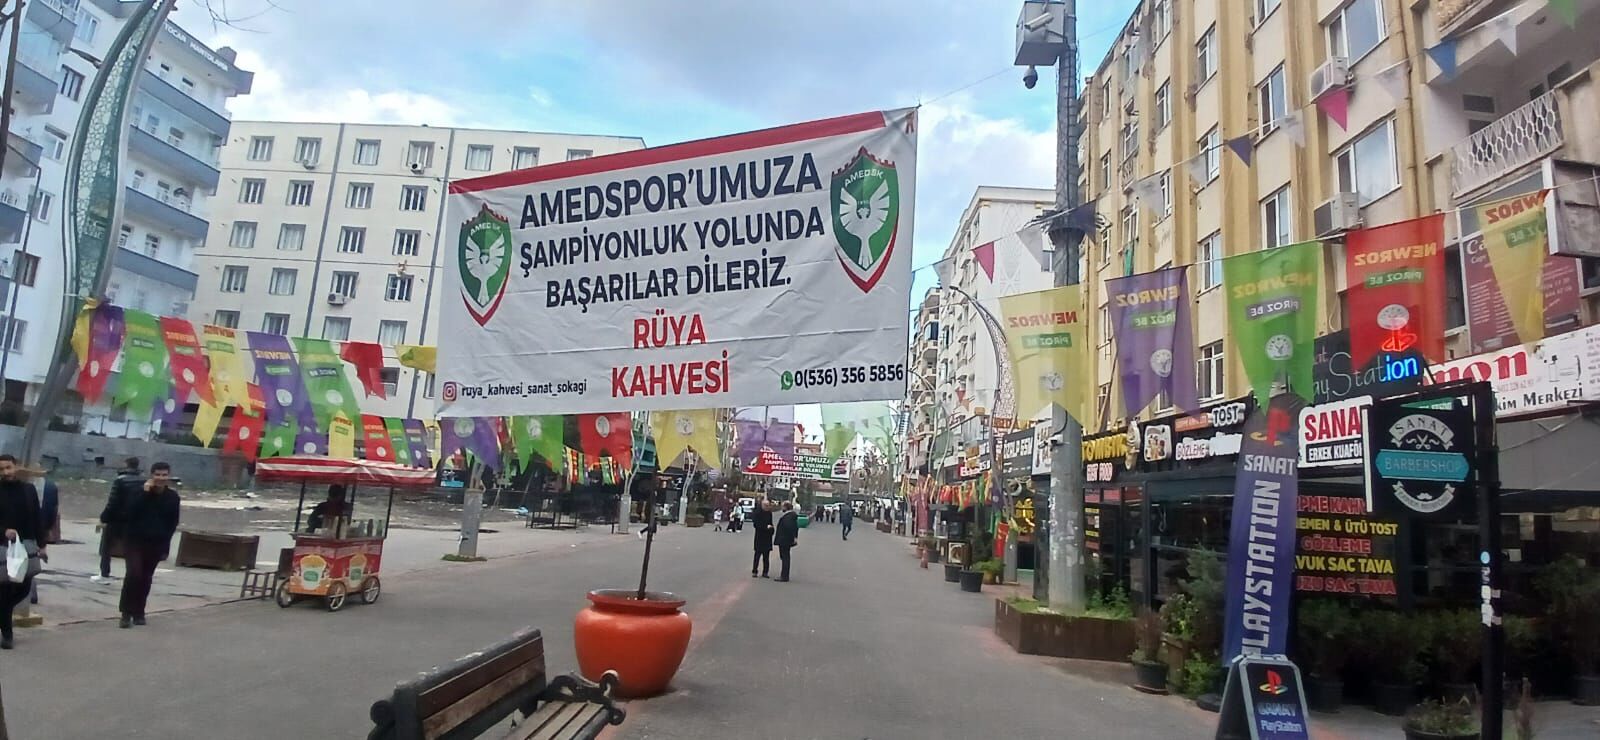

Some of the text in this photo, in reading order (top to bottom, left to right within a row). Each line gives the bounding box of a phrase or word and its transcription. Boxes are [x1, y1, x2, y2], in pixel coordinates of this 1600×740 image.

[520, 152, 823, 229] AMEDSPOR'UMUZA
[520, 206, 824, 278] ŞAMPİYONLUK YOLUNDA
[546, 248, 791, 313] BAŞARILAR DİLERİZ.
[634, 309, 707, 349] RÜYA
[612, 350, 729, 397] KAHVESİ
[794, 364, 903, 388] 0(536) 356 5856
[462, 379, 587, 399] ruya_kahvesi_sanat_sokagi
[1212, 405, 1239, 425] TOST
[1305, 406, 1362, 441] SANA
[1394, 417, 1447, 439] SANAT
[1309, 448, 1333, 461] ERKEK
[1244, 455, 1295, 475] SANAT
[1385, 457, 1463, 474] BARBERSHOP
[1334, 520, 1341, 532] &
[1345, 519, 1368, 534] ÜTÜ
[1369, 522, 1398, 535] TOST
[1302, 534, 1371, 554] GÖZLEME
[1328, 557, 1356, 572] SAC
[1359, 559, 1394, 574] TAVA
[1325, 577, 1356, 593] SAC
[1357, 579, 1397, 595] TAVA
